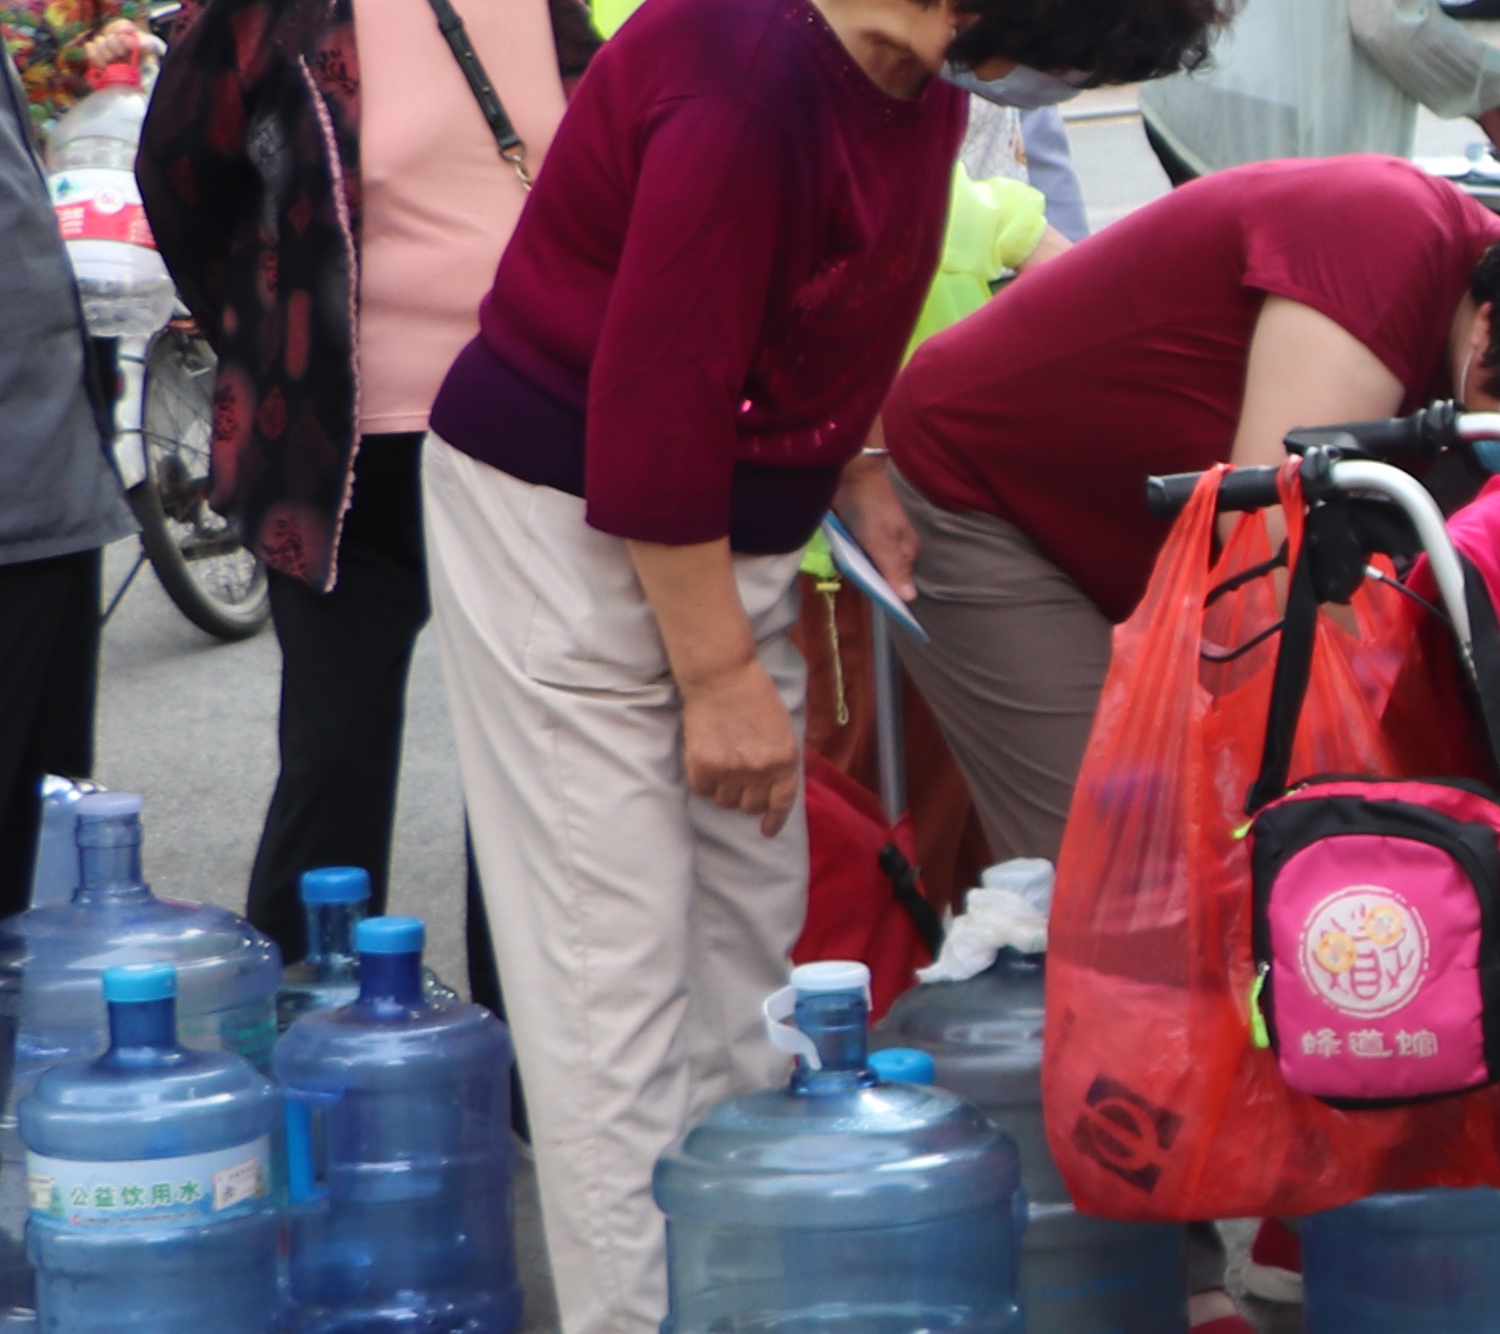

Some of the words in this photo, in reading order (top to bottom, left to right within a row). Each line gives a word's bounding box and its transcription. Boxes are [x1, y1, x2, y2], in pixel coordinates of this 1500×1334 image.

[71, 1179, 202, 1208] 公益饮用水
